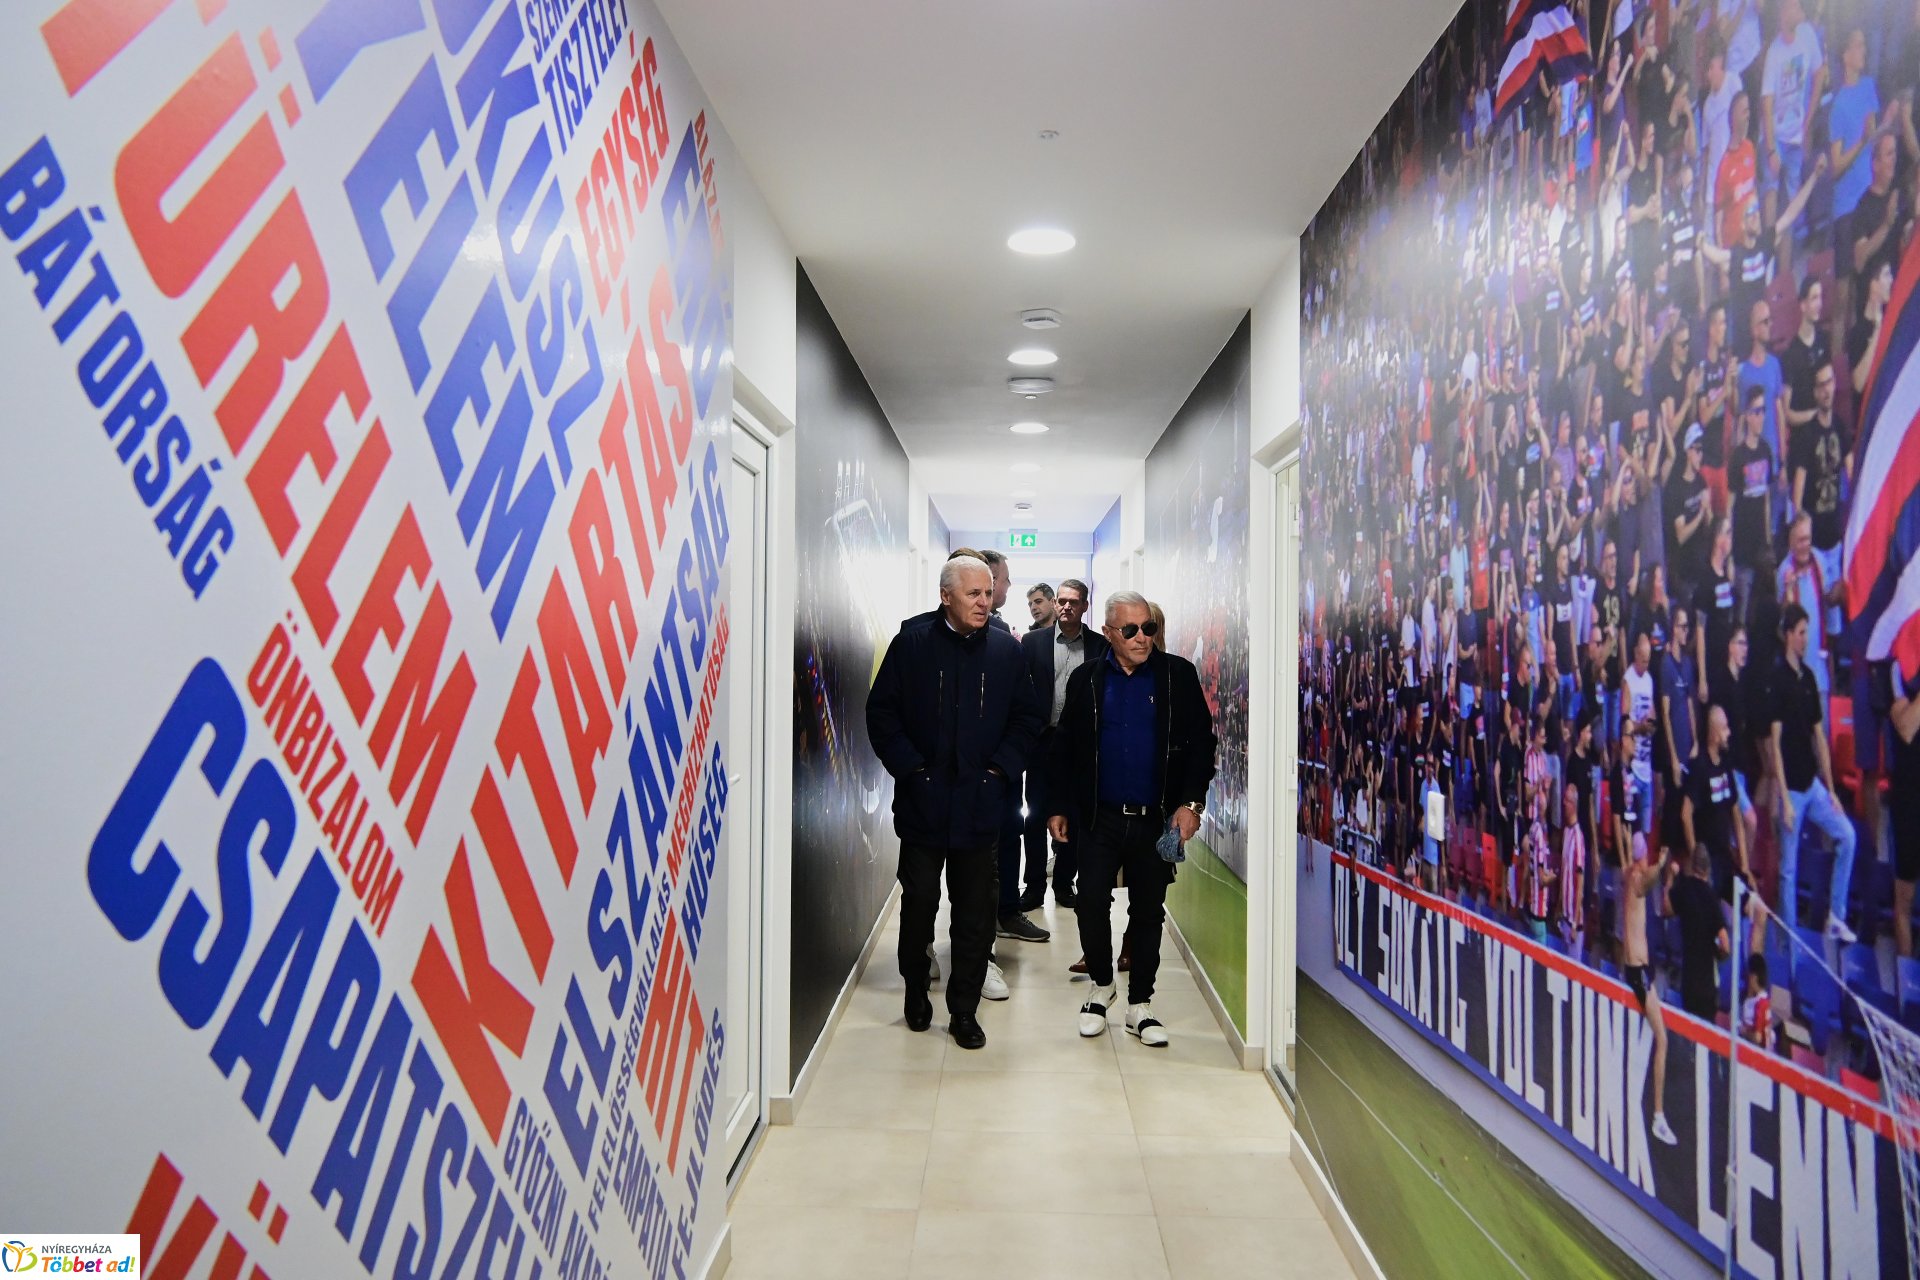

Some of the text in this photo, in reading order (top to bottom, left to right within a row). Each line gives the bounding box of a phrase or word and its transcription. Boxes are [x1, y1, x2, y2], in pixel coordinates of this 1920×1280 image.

[431, 0, 604, 491] KUSZ
[575, 29, 670, 317] EGYSÉG
[0, 134, 234, 601] BÁTORSÁG
[247, 609, 404, 939] ÖNBIZALOM
[410, 263, 693, 1148] KITARTÁS
[543, 441, 730, 1183] ELSZÁNTSÁG
[666, 602, 730, 890] MEGBÍZHATÓSÁG
[681, 740, 728, 966] HŰSÉG
[504, 1097, 567, 1260] GYŐZNI
[588, 871, 671, 1235] FELELŐSSÉGVÁLLALÁS
[635, 905, 705, 1178] HIT
[671, 1007, 724, 1280] FEJLŐDÉS
[1377, 883, 1467, 1054] SOKÁIG
[1484, 933, 1656, 1198] VOLTUNK
[1696, 1042, 1881, 1280] LENN
